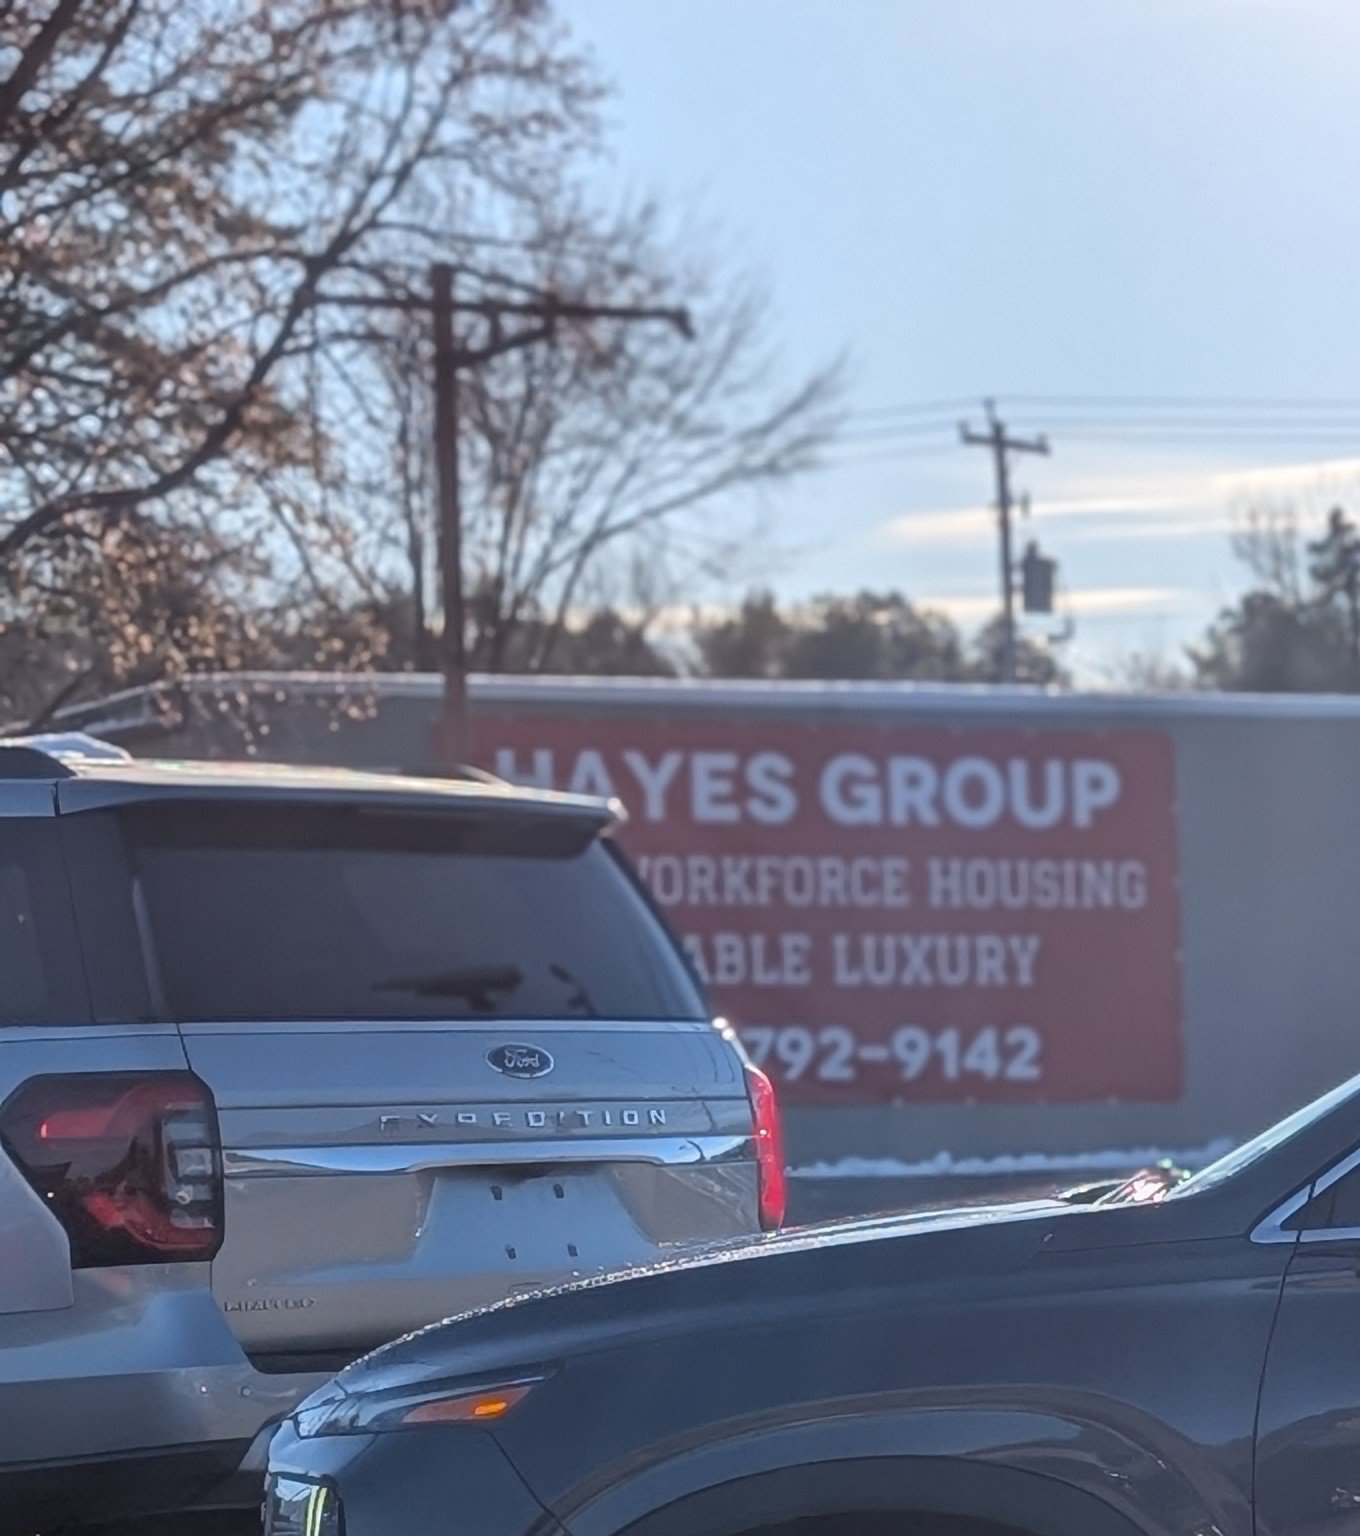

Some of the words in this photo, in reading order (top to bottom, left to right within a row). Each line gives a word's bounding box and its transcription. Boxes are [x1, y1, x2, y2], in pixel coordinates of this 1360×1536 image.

[496, 747, 799, 824] HAYES
[819, 753, 1121, 829] GROUP
[640, 856, 909, 906] ORKFORCE
[929, 858, 1147, 911] HOUSING
[833, 934, 1041, 987] LUXURY
[503, 1048, 540, 1069] Ford
[744, 1026, 1041, 1081] 792-9142
